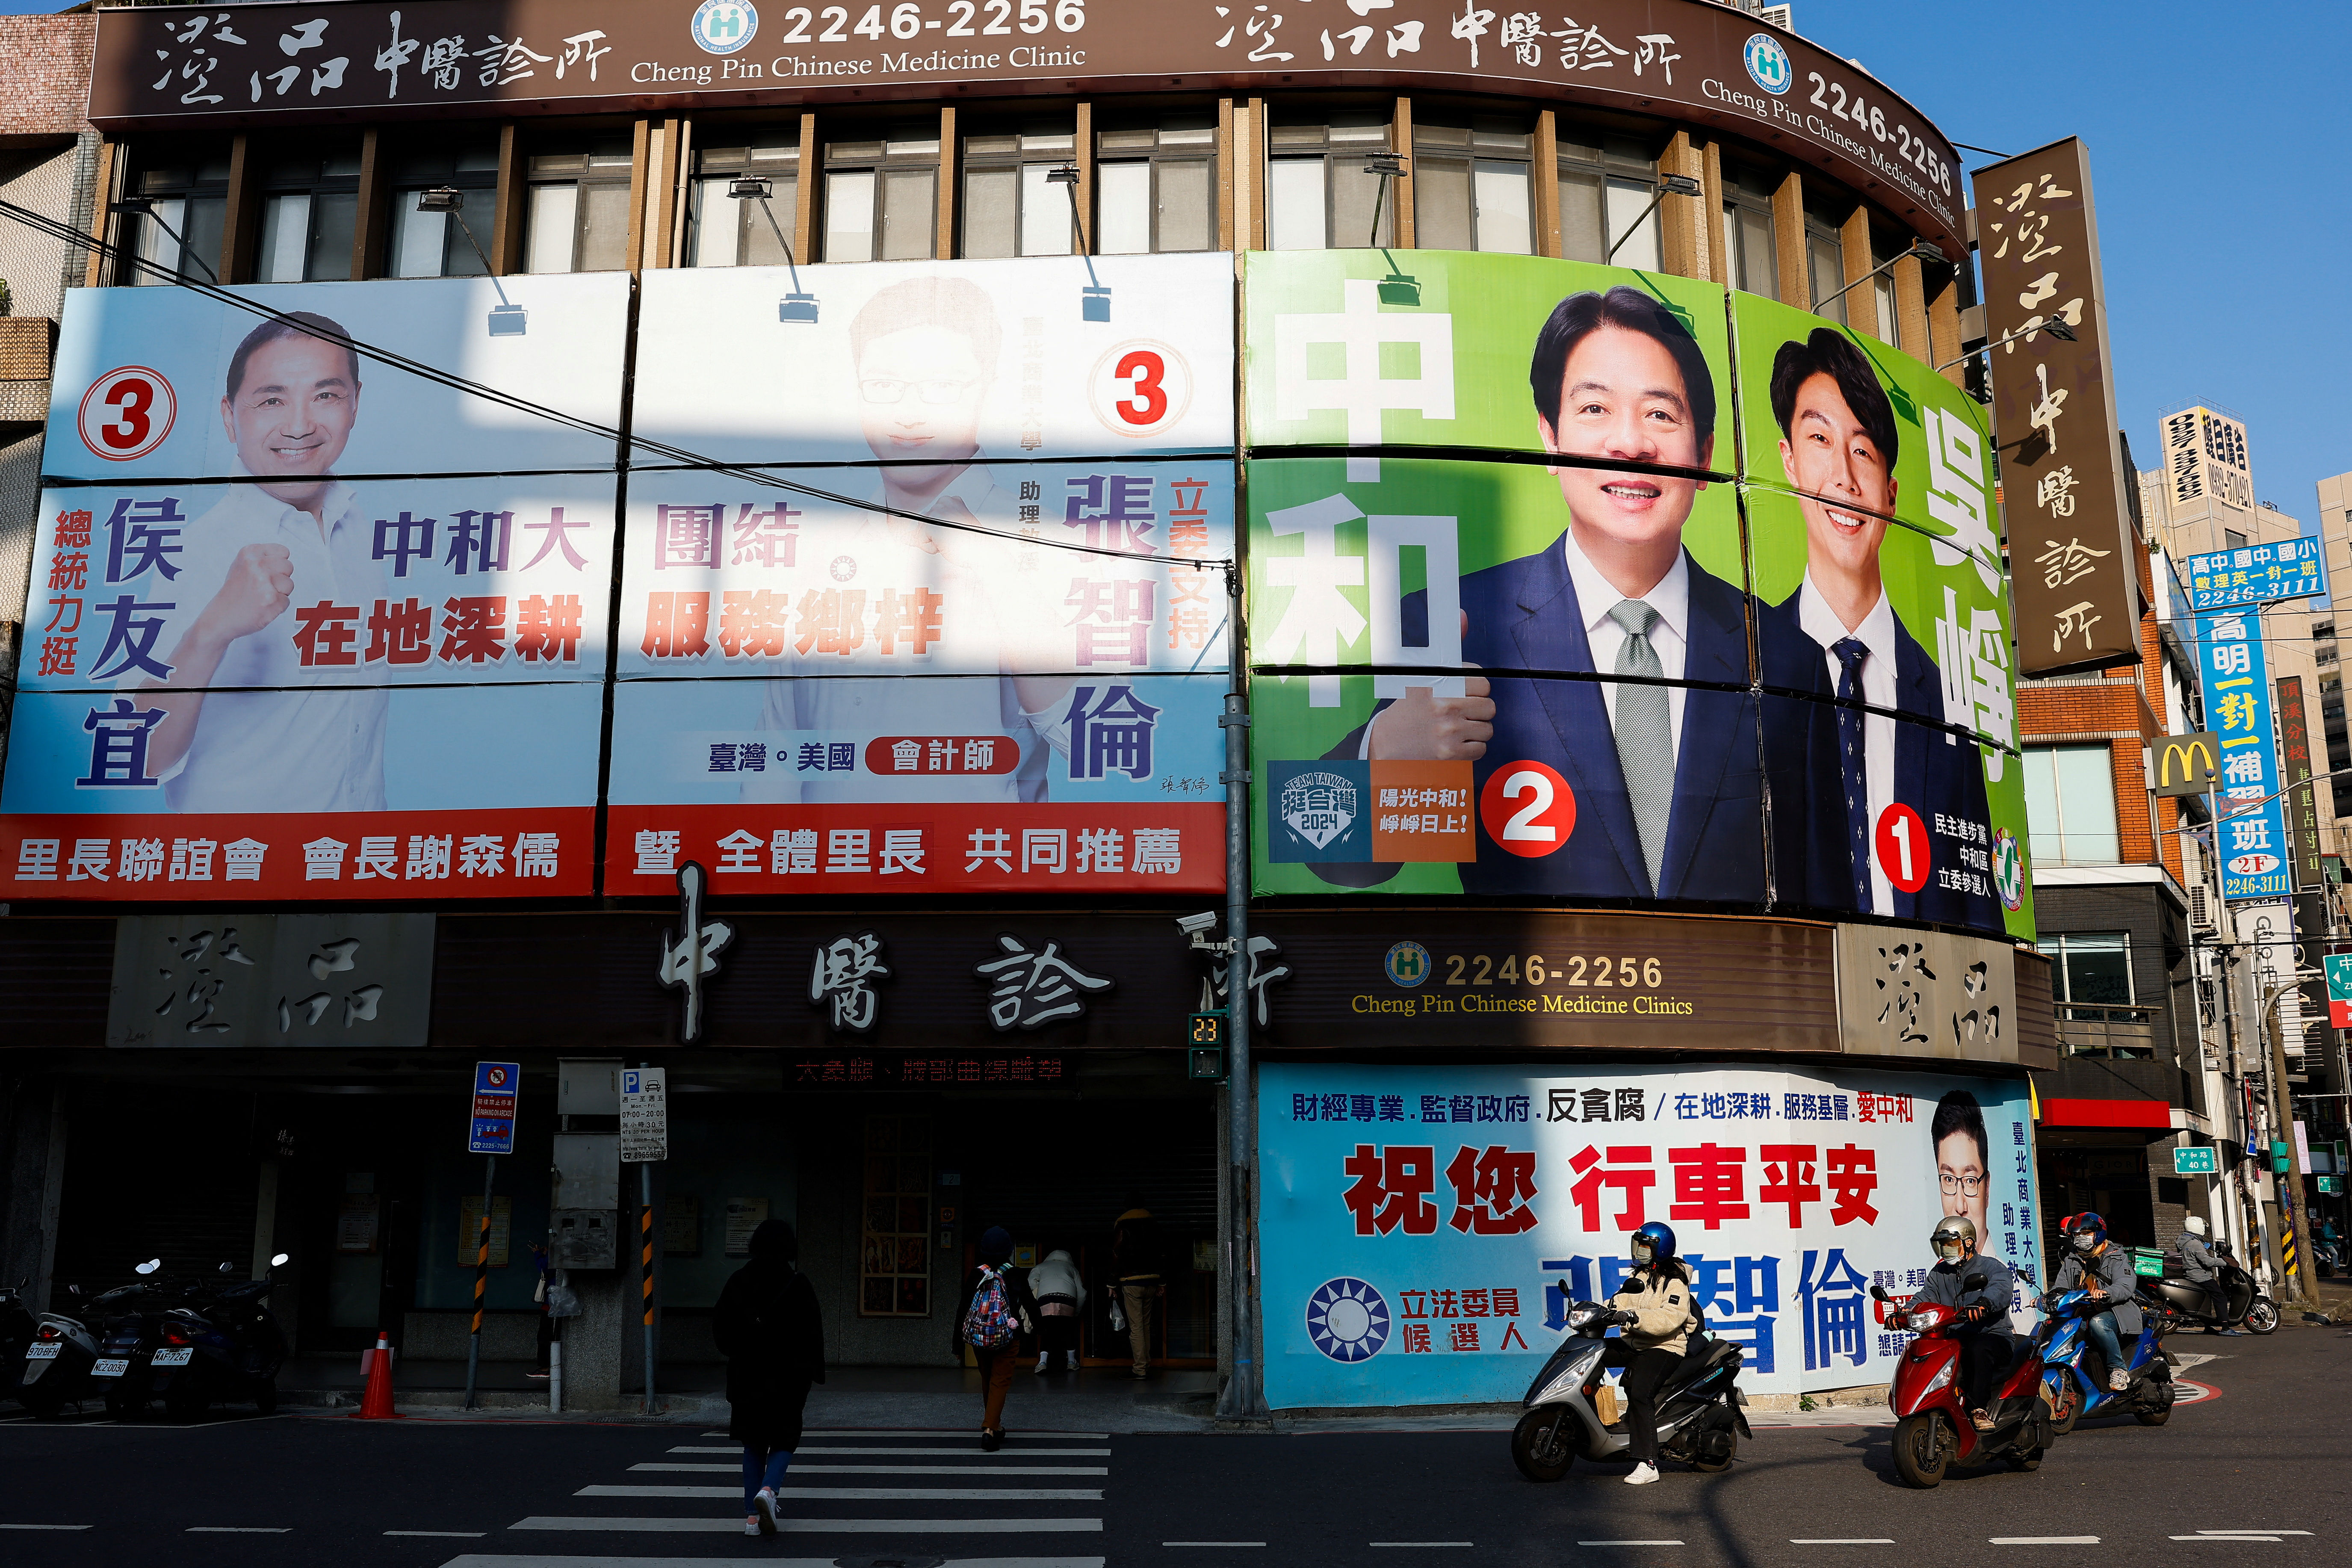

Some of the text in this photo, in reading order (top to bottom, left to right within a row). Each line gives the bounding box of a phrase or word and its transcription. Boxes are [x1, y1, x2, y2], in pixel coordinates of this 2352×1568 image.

[695, 25, 708, 47] NATIONAL
[733, 23, 754, 48] INSURANCE
[783, 0, 1085, 43] 2246-2256
[631, 45, 1086, 85] Cheng Pin Chinese Medicine Clinic
[1746, 57, 1790, 92] NATIONAL HEALTH INSURANCE
[1702, 79, 1955, 228] Cheng Pin Chinese Medicine Clinic
[1808, 71, 1951, 197] 2246-2256
[1115, 351, 1167, 425] 3
[101, 378, 154, 449] 3
[1264, 279, 1466, 707] 中和
[2208, 462, 2252, 508] 0932-370421
[1018, 481, 1041, 572] 助理教授
[1168, 477, 1210, 650] 立委支持
[2195, 560, 2317, 592] 數理英一對一班
[38, 509, 93, 676] 總統力挺
[1923, 404, 2014, 782] 吳崢
[2198, 577, 2319, 607] 2246-3111
[75, 497, 186, 787] 侯友宜
[292, 587, 944, 667] 在地深耕 服務鄉梓
[1061, 475, 1160, 780] 張智倫
[2208, 611, 2271, 850] 高明一對一補習班
[2280, 682, 2308, 761] 頂溪分校
[891, 739, 995, 771] 會計師
[1285, 772, 1353, 790] TEAM TAIWAN
[1282, 788, 1356, 820] 挺台灣
[1301, 813, 1338, 830] 2024
[1503, 771, 1557, 842] 2
[633, 827, 1182, 875] 暨 全體里長 共同推薦
[1891, 815, 1913, 881] 1
[1935, 813, 1987, 846] 民主進步黨
[14, 833, 560, 882] 里長聯誼會 會長謝森儒
[1960, 845, 1989, 871] 中和區
[2238, 855, 2267, 874] 2F
[1938, 867, 1991, 898] 立委參選人
[2226, 874, 2287, 897] 2246-3111
[1386, 962, 1398, 981] NATIONAL
[1415, 963, 1429, 983] INSURANCE
[1446, 954, 1662, 988] 2246-2256
[1352, 995, 1693, 1017] Cheng Pin Chinese Medicine Clinics
[1193, 1018, 1217, 1041] 23
[626, 1074, 637, 1092] P
[1344, 1143, 1879, 1236] 祝您 行車平安
[2012, 1121, 2036, 1288] 臺北商業大學
[2003, 1202, 2022, 1314] 助理教授
[1400, 1288, 1521, 1319] 立法委員
[1402, 1322, 1528, 1353] 候選人
